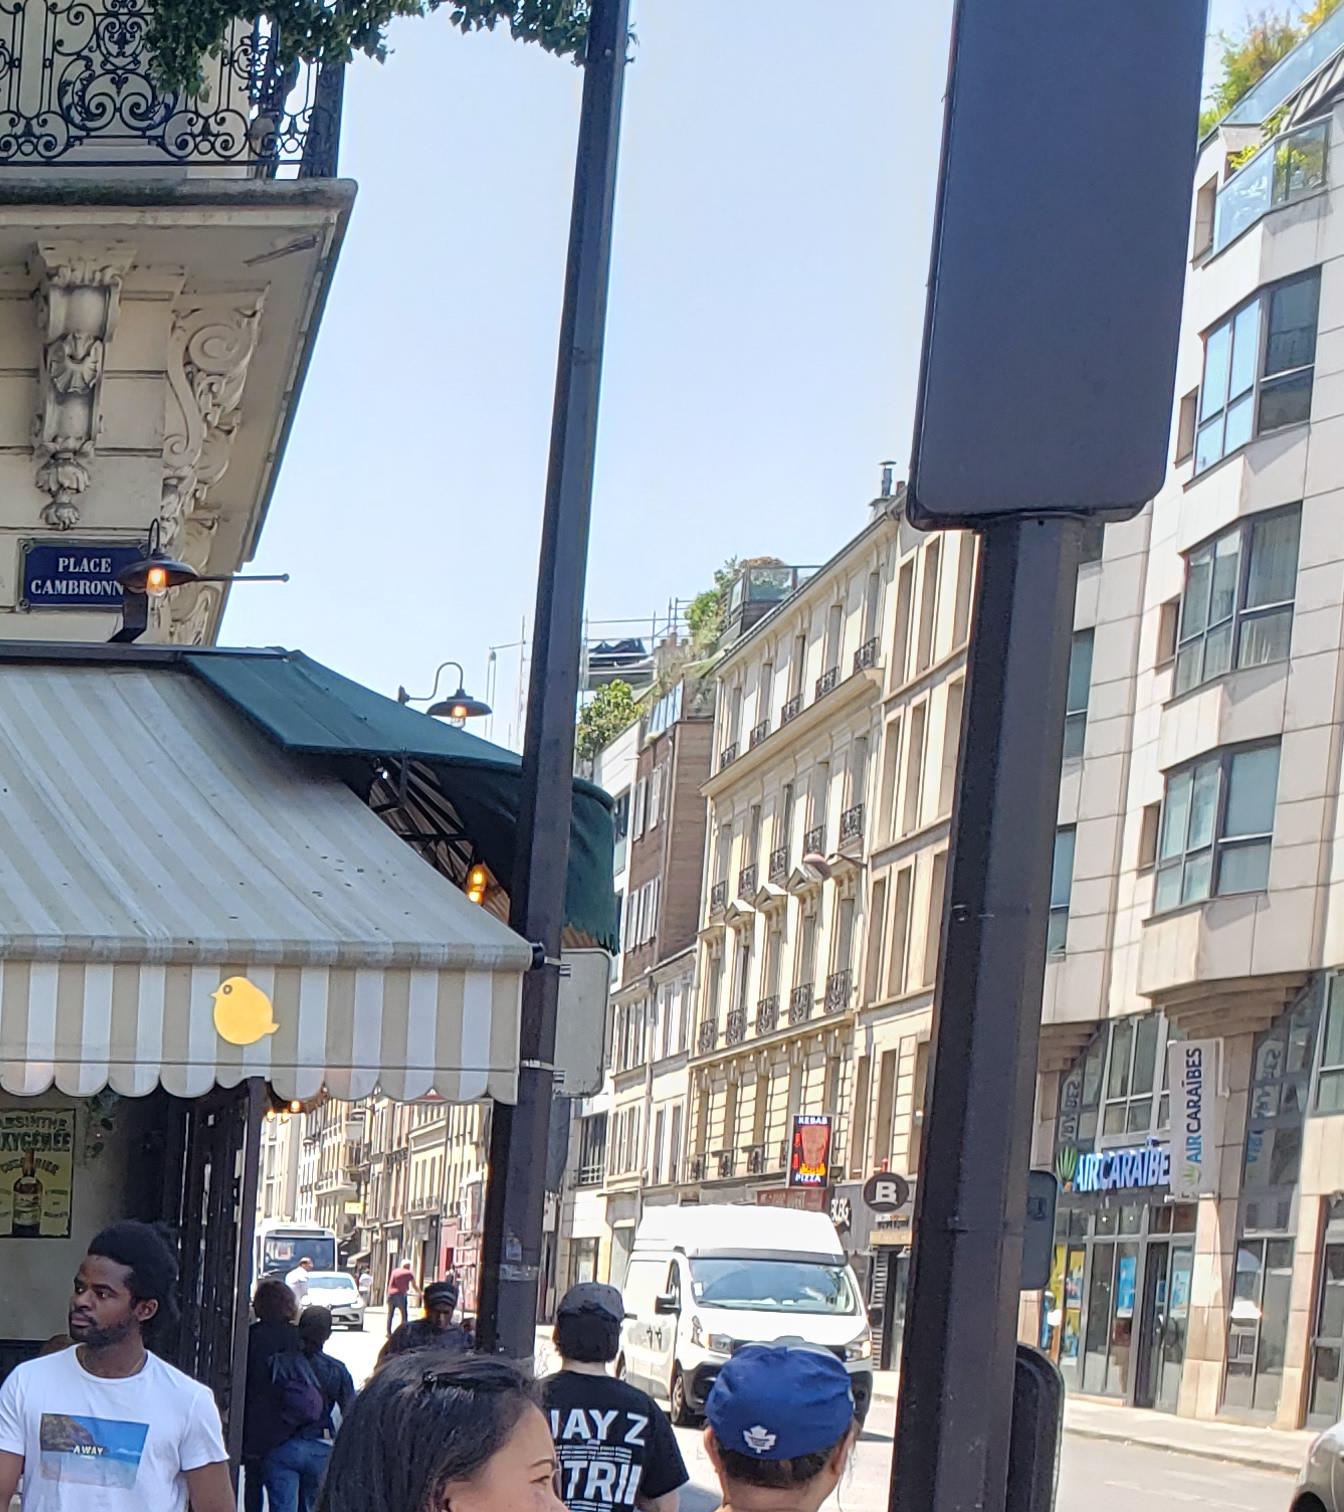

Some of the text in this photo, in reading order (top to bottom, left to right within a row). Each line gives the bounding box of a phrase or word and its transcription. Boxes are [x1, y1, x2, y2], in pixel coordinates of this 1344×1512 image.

[58, 557, 112, 573] PLACE
[31, 579, 124, 596] CAMBRONN
[798, 1116, 828, 1126] KEBAB
[795, 1173, 822, 1183] PIZZA
[869, 1180, 898, 1205] B
[624, 1412, 649, 1447] Z
[73, 1445, 104, 1455] AWAY
[563, 1460, 643, 1505] TRII
